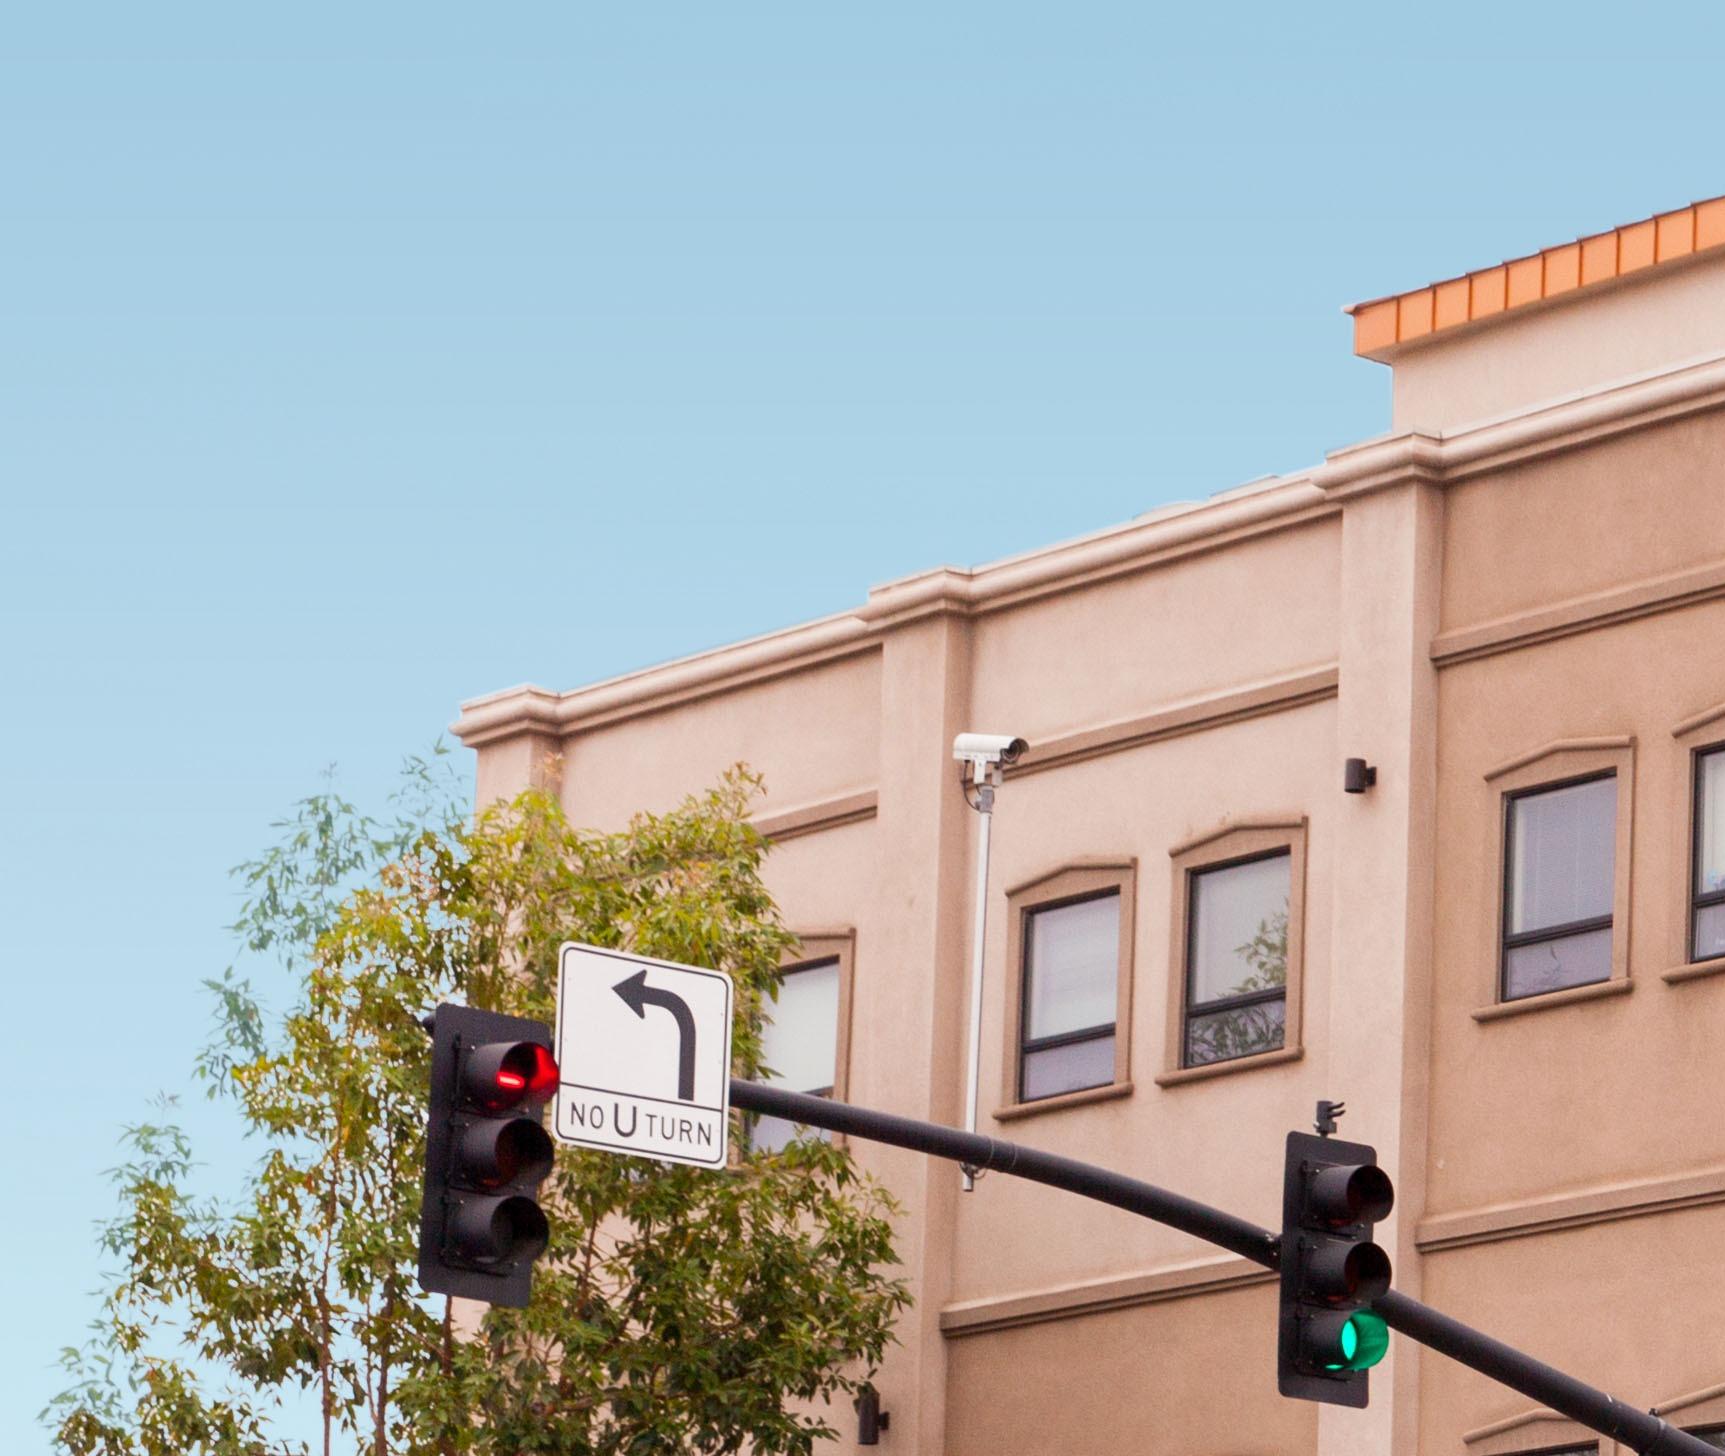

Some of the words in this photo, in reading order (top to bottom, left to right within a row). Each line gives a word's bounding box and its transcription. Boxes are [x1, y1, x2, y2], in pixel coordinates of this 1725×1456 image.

[570, 1101, 604, 1129] NO
[614, 1102, 637, 1138] U
[645, 1112, 712, 1146] TURN
